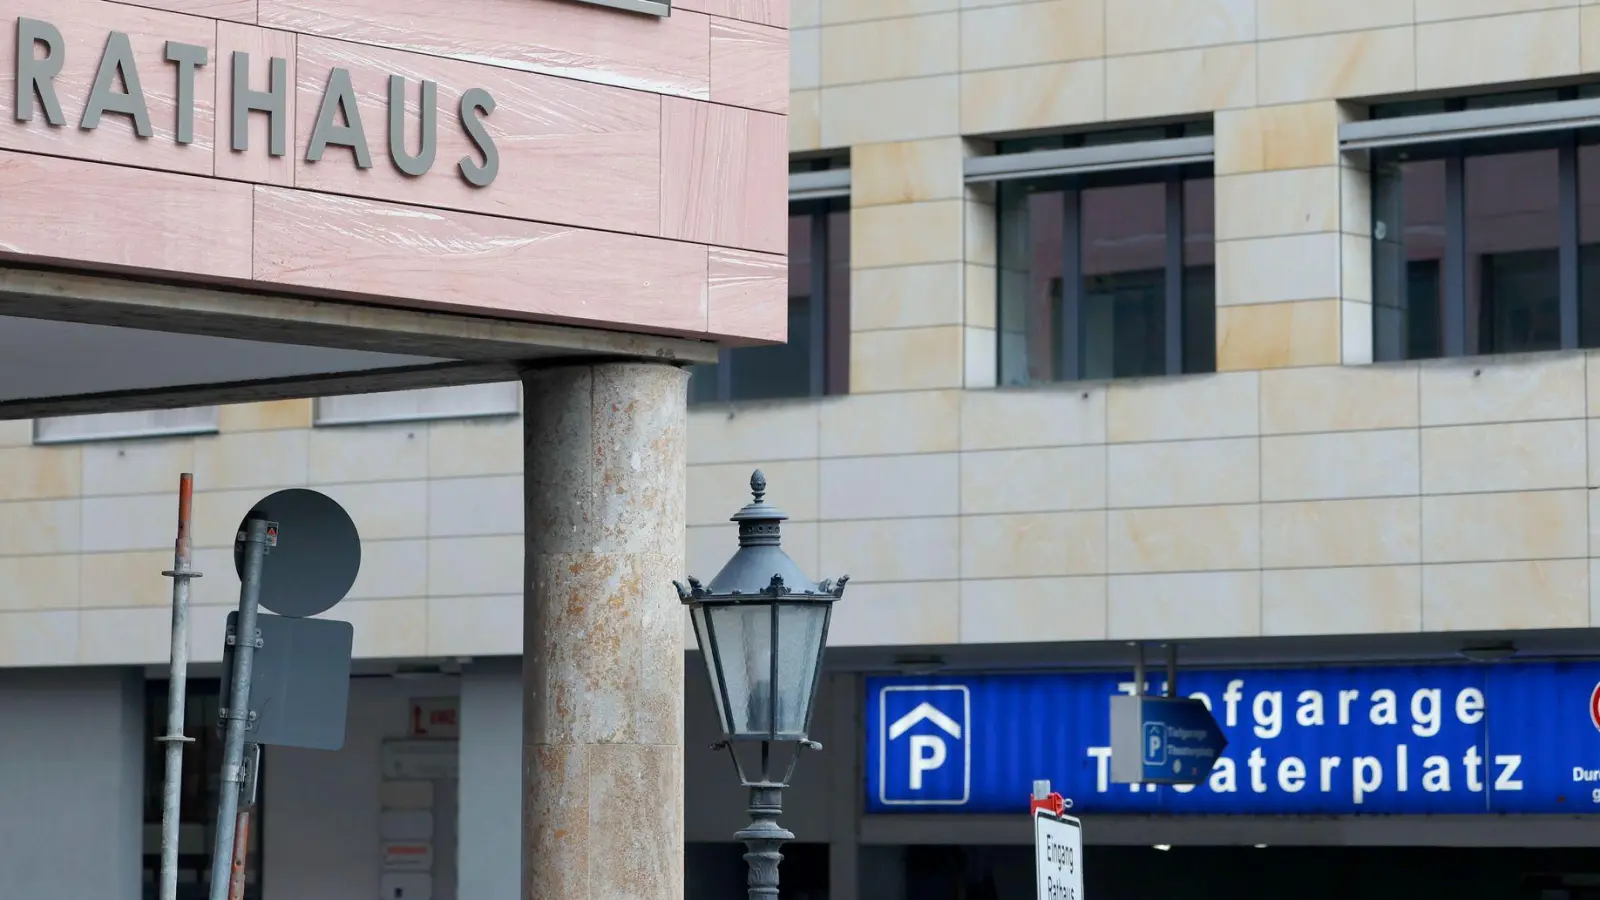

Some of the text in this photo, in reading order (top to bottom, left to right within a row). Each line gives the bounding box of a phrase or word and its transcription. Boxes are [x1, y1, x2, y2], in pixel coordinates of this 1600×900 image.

[16, 16, 500, 187] RATHAUS
[1118, 679, 1485, 738] fgarage
[909, 734, 947, 790] P
[1087, 744, 1524, 804] Taterplatz
[1572, 766, 1600, 782] Dur
[1046, 833, 1074, 875] Eingang
